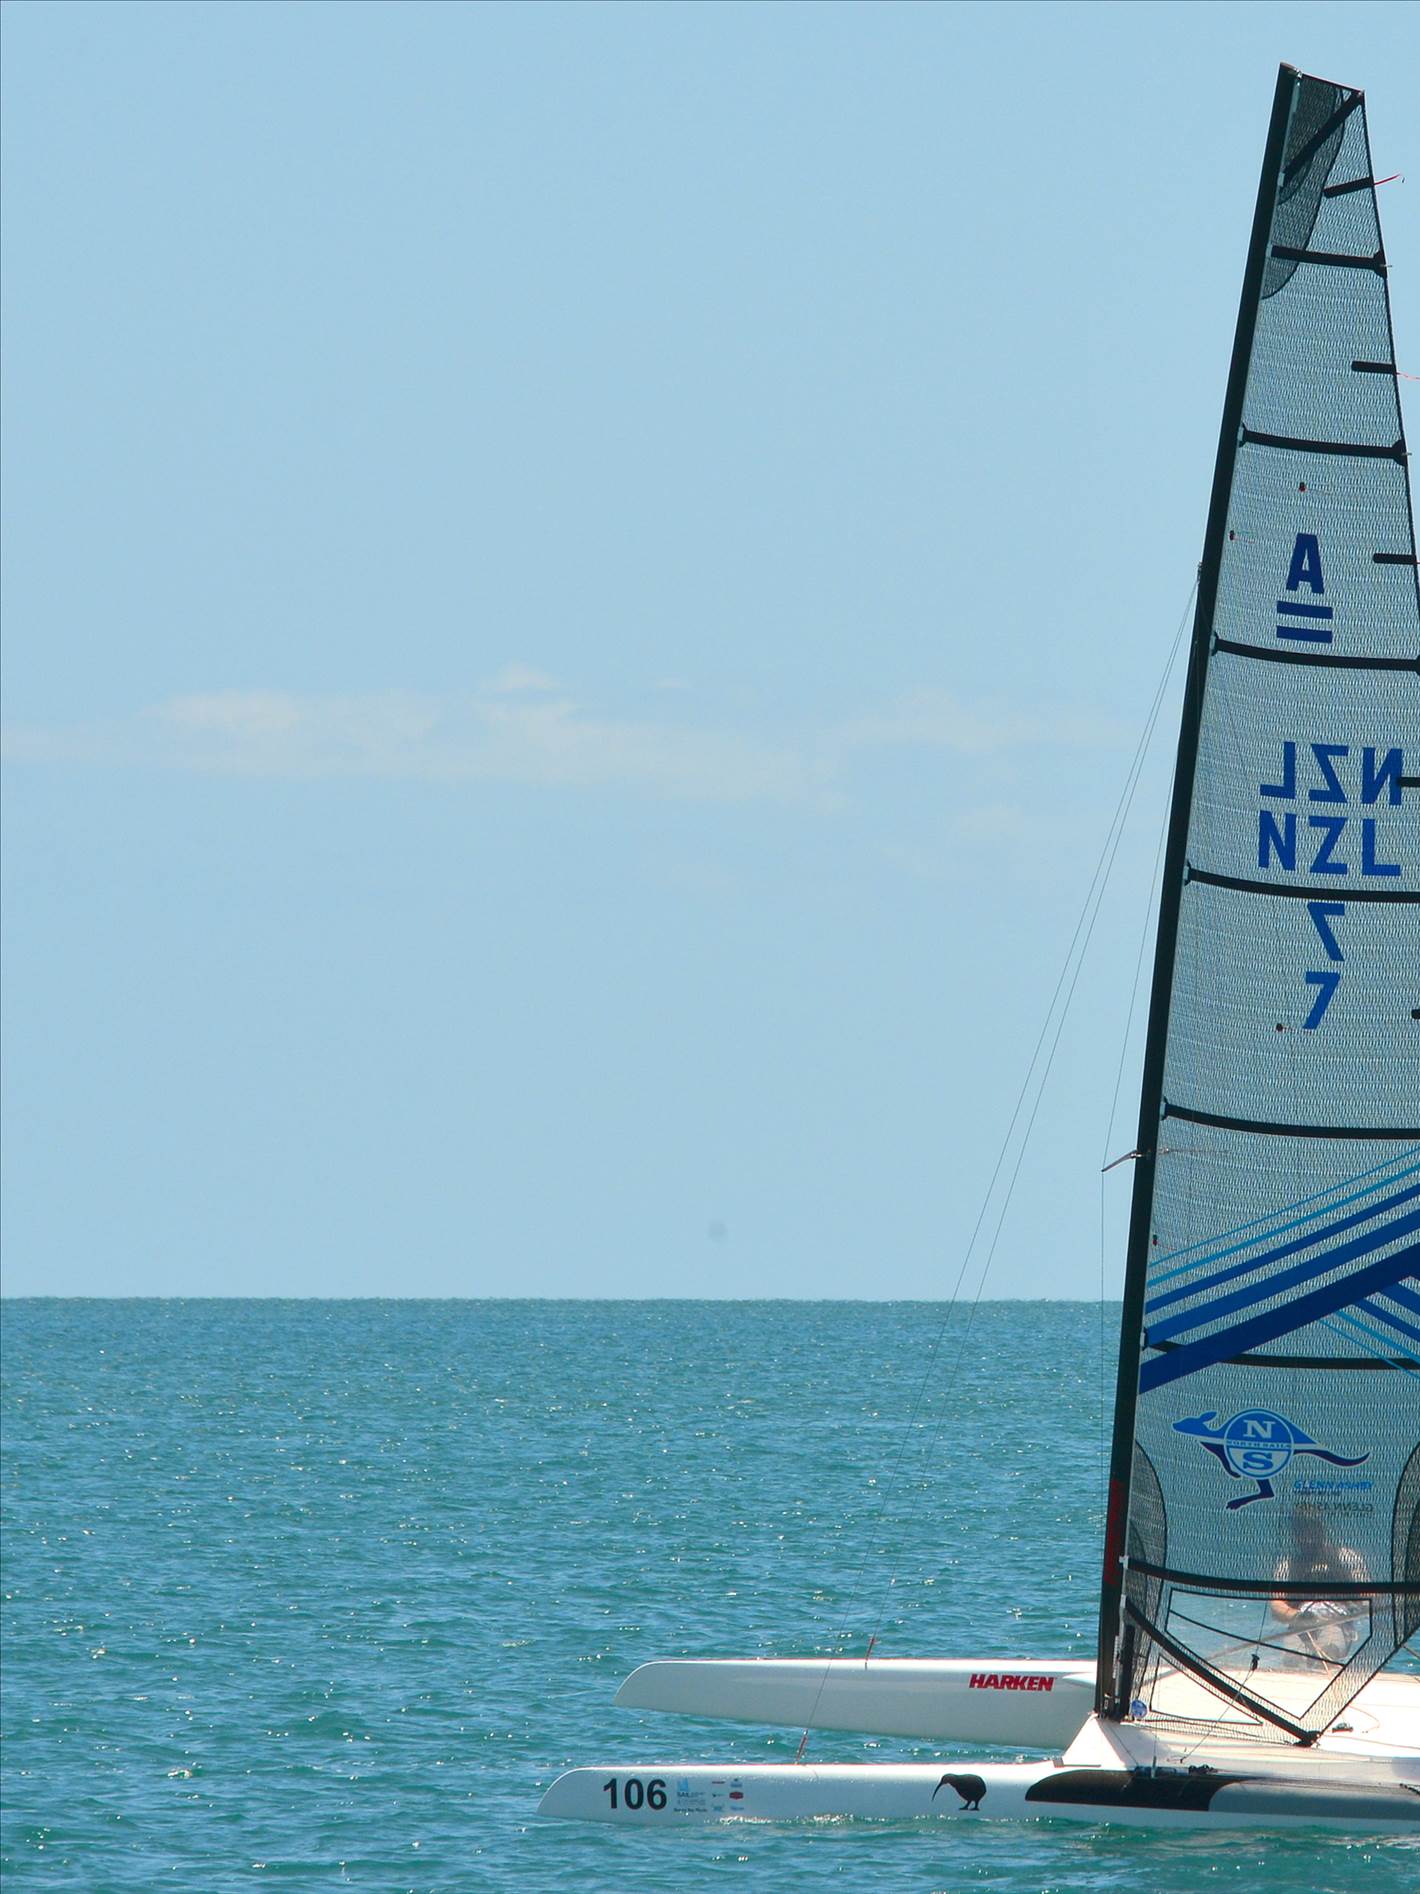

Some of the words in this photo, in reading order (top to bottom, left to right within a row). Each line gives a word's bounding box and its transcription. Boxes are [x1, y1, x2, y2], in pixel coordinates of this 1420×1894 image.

[1286, 533, 1324, 594] A
[1257, 809, 1402, 877] NZL
[1302, 969, 1342, 1030] 7
[1243, 1419, 1276, 1439] N
[1242, 1451, 1274, 1470] S
[969, 1674, 1055, 1692] HARKEN
[603, 1778, 667, 1810] 106
